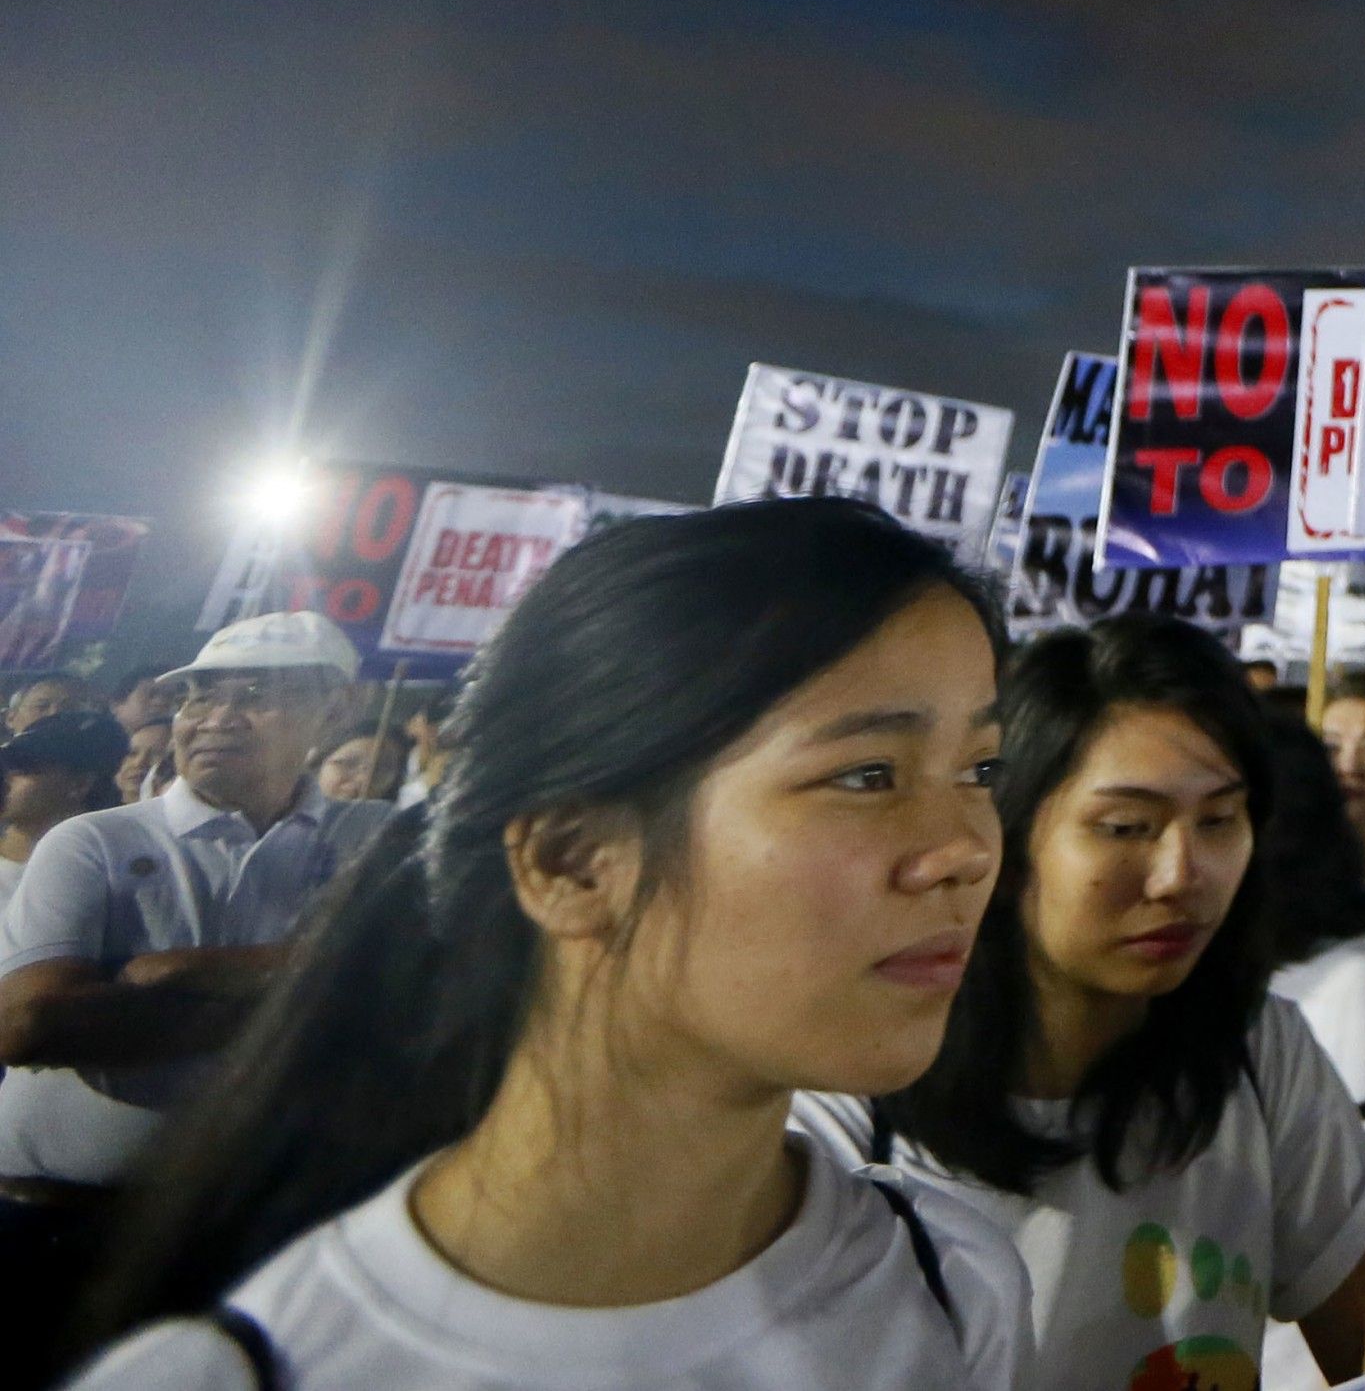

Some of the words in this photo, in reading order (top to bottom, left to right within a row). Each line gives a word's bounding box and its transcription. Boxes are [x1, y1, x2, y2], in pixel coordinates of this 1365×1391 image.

[1129, 283, 1289, 422] NO
[774, 374, 978, 454] STOP
[764, 445, 969, 523] DEATH
[1135, 444, 1275, 515] TO
